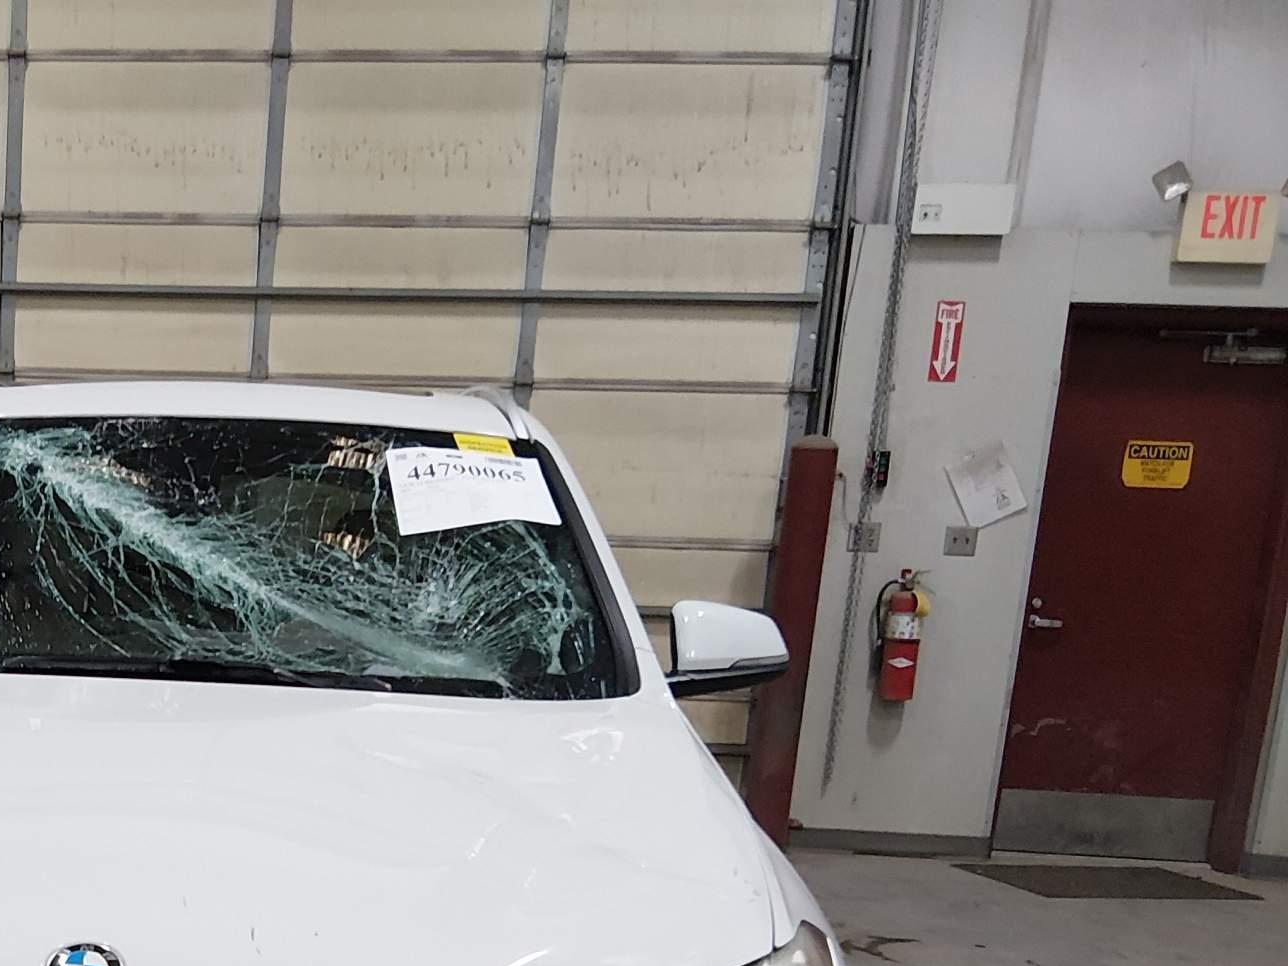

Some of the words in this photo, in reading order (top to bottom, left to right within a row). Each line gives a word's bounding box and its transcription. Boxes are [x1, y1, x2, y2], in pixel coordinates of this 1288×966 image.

[1200, 195, 1267, 240] EXIT
[941, 308, 960, 320] FIRE
[1130, 445, 1189, 459] CAUTION
[407, 461, 527, 483] 44790065
